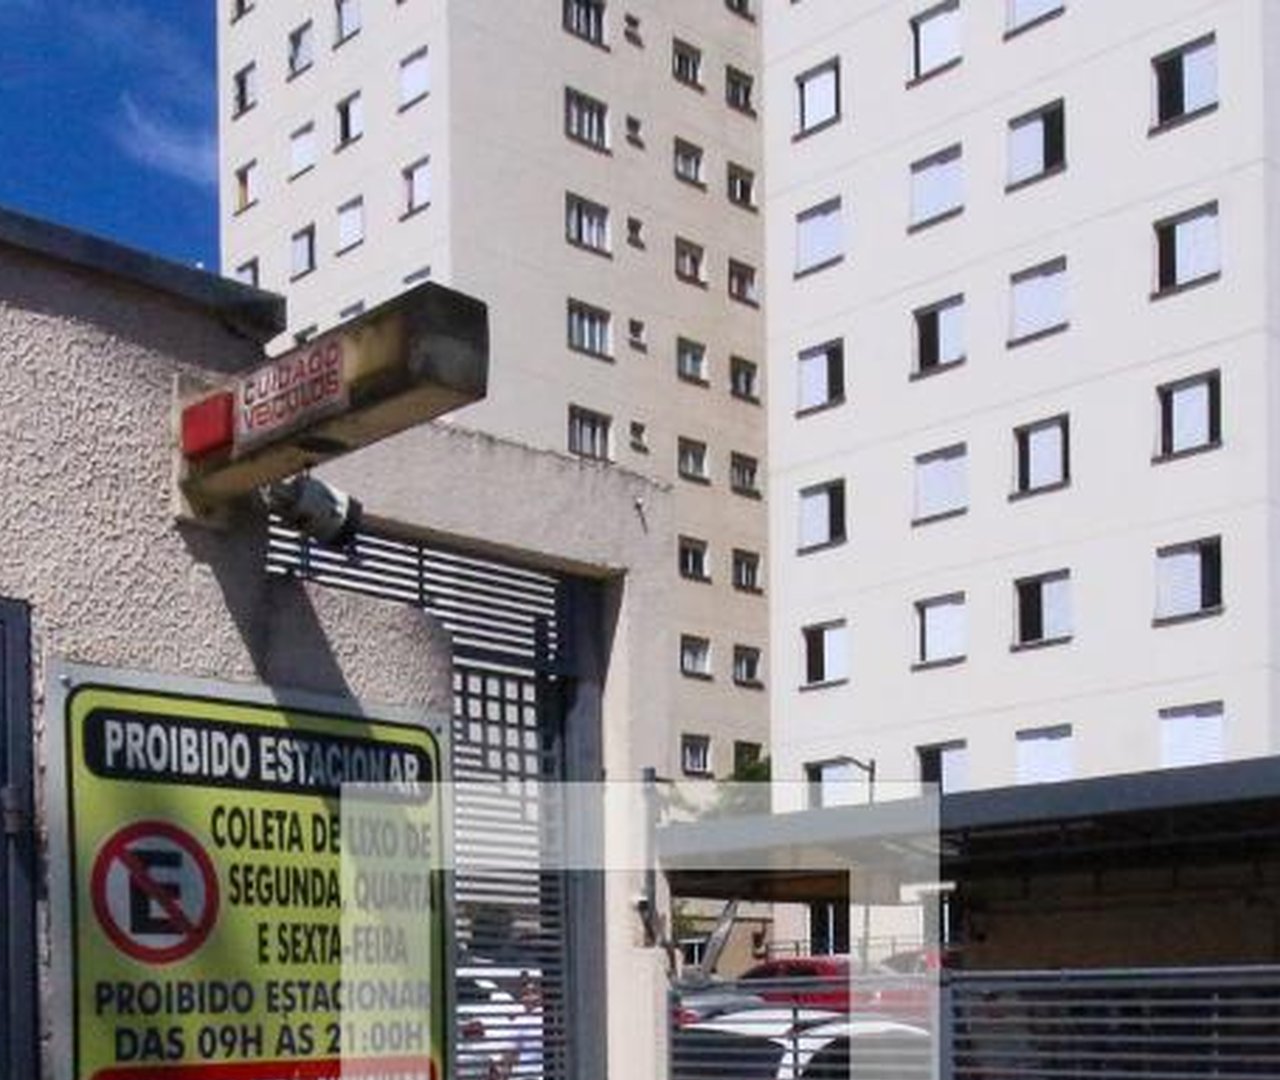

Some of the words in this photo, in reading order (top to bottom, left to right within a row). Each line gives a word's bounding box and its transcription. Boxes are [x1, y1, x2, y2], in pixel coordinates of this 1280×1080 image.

[103, 719, 251, 778] PROIBIDO
[260, 736, 422, 795] ESTACIONAR
[210, 805, 304, 853] COLETA
[311, 812, 342, 855] DE
[347, 813, 399, 858] LIXO
[406, 821, 432, 859] DE
[353, 871, 436, 915] QUARTA
[257, 923, 270, 963] E
[278, 921, 409, 966] SEXTA-FEIRA
[95, 980, 255, 1017] PROIBIDO
[266, 980, 432, 1014] ESTACIONAR
[114, 1026, 185, 1062] DAS
[197, 1023, 263, 1059] 09H
[323, 1021, 425, 1056] 21:00H
